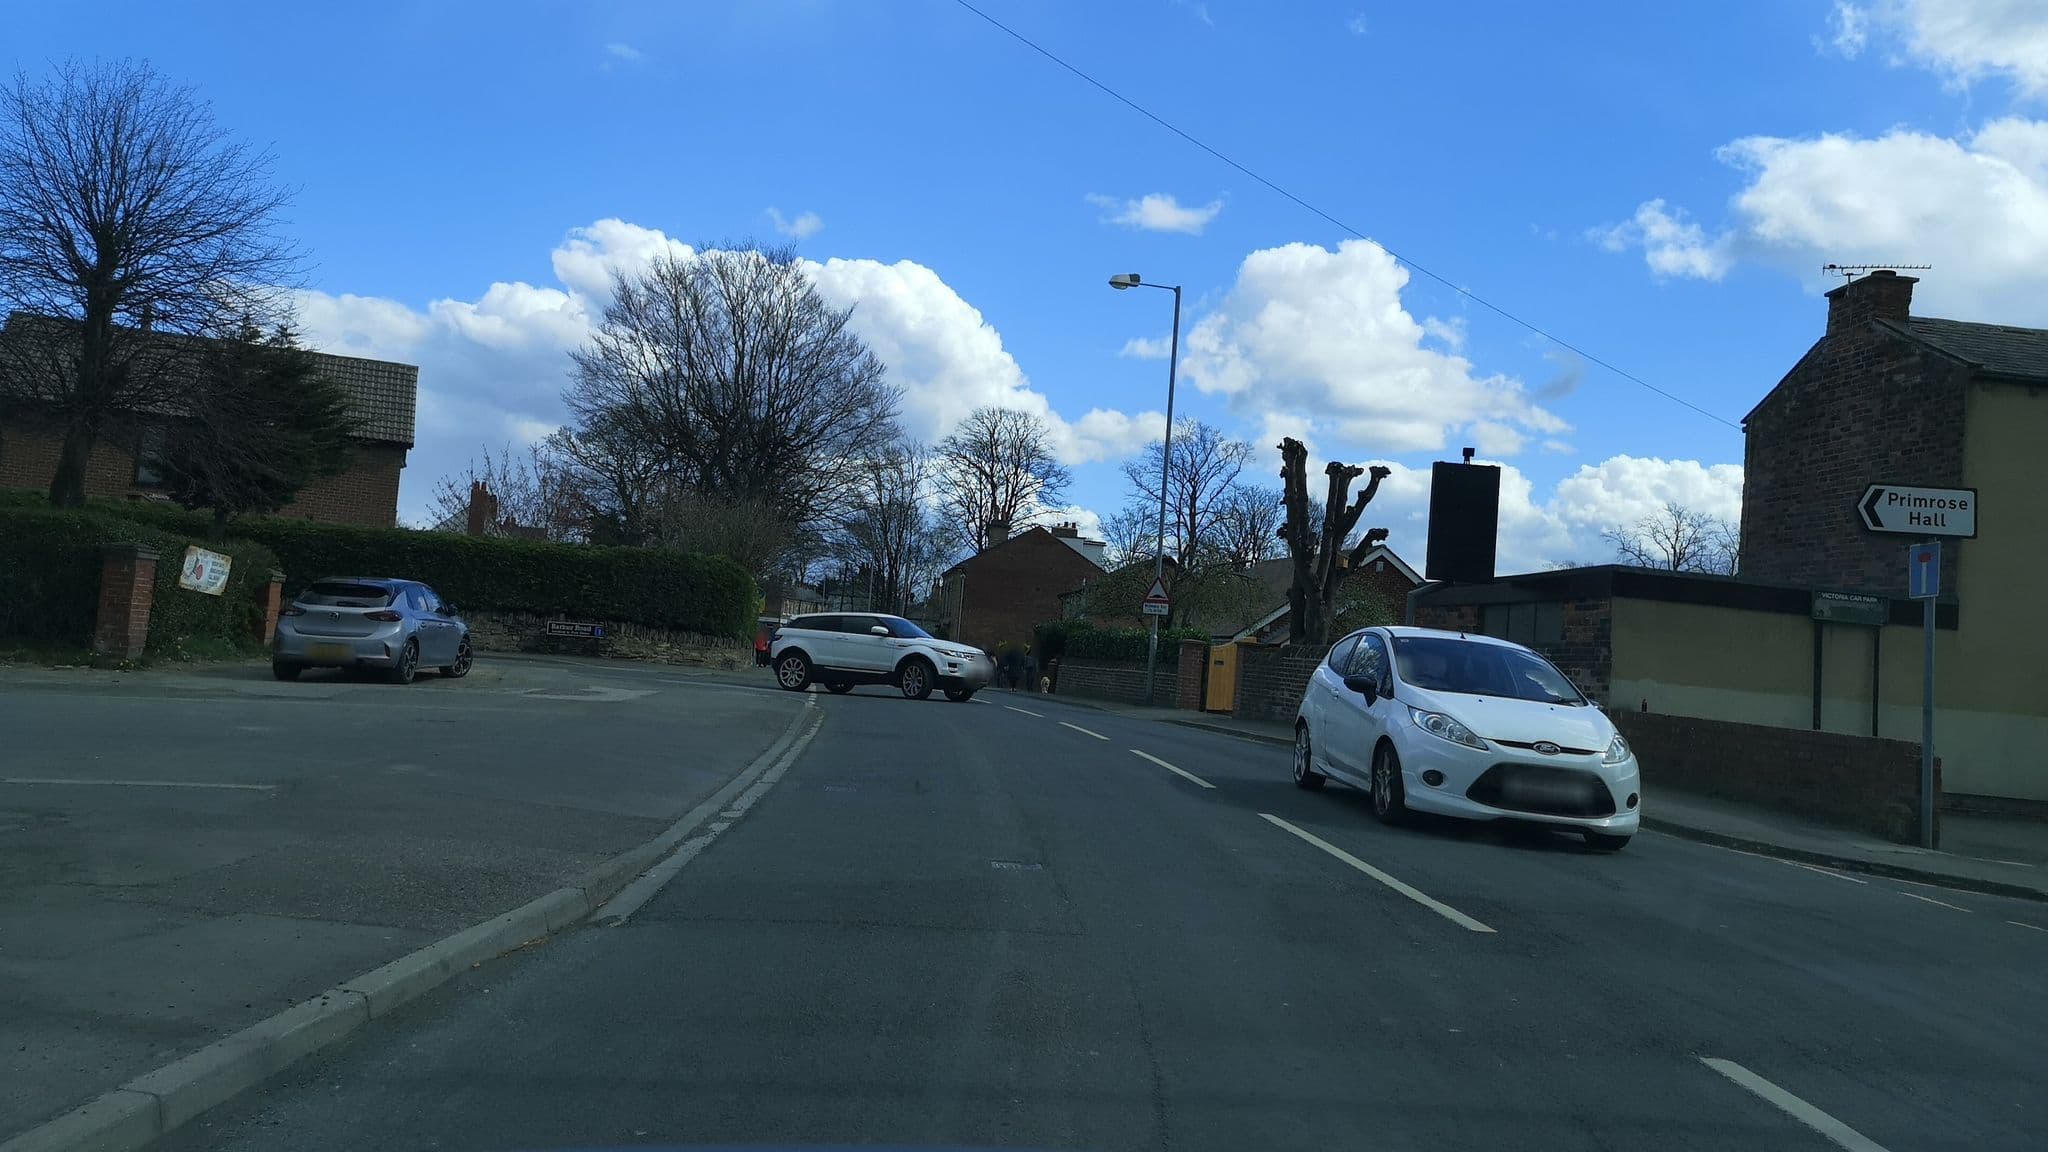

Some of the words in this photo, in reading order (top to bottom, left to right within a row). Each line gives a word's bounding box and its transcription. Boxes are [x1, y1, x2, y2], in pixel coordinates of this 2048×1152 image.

[1888, 492, 1968, 510] Primrose
[1909, 511, 1946, 527] Hall
[1821, 592, 1848, 600] VICTORIA
